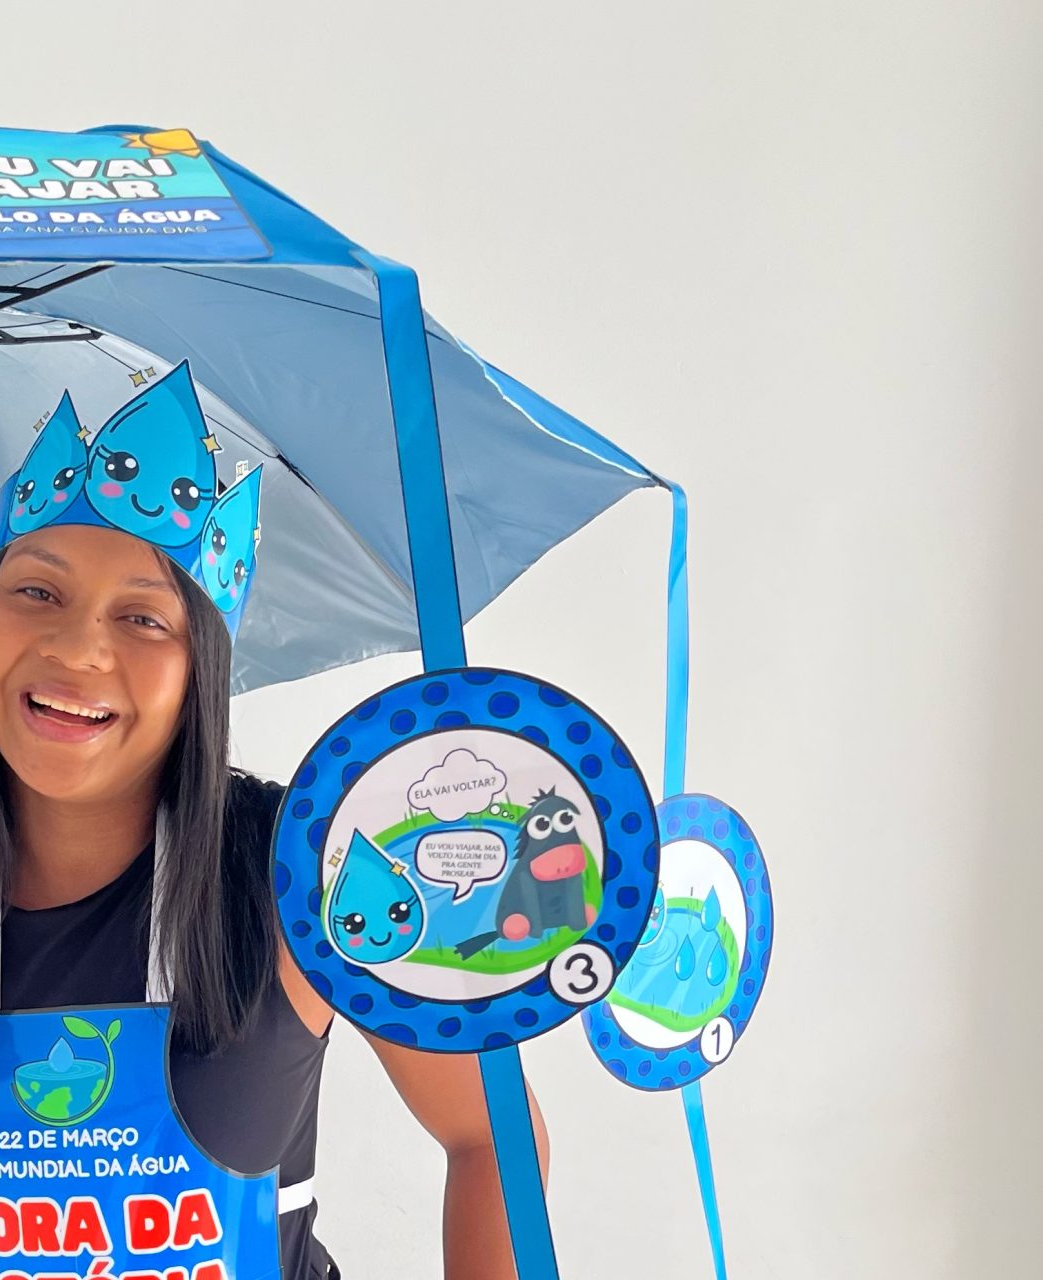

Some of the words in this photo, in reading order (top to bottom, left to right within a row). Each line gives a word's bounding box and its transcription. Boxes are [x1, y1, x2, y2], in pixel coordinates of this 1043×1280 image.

[48, 157, 176, 178] VAI
[49, 211, 104, 225] DA
[117, 208, 221, 224] ÁGUA
[25, 225, 63, 234] ANA
[162, 225, 208, 234] DIAS
[414, 788, 433, 799] ELA
[434, 785, 451, 796] VAI
[453, 776, 497, 793] VOLTAR?
[425, 843, 436, 851] EU
[437, 843, 455, 851] VOU
[484, 844, 501, 852] MAS
[428, 852, 453, 860] VOLTO
[454, 852, 482, 860] ALGUM
[483, 852, 497, 860] DIA
[457, 861, 482, 869] GENTE
[565, 953, 599, 995] 3
[711, 1024, 721, 1056] 1
[0, 1131, 24, 1149] 22
[28, 1129, 57, 1148] DE
[62, 1127, 139, 1151] MARÇO
[94, 1158, 124, 1177] DA
[128, 1153, 190, 1176] ÁGUA
[124, 1188, 222, 1253] DA
